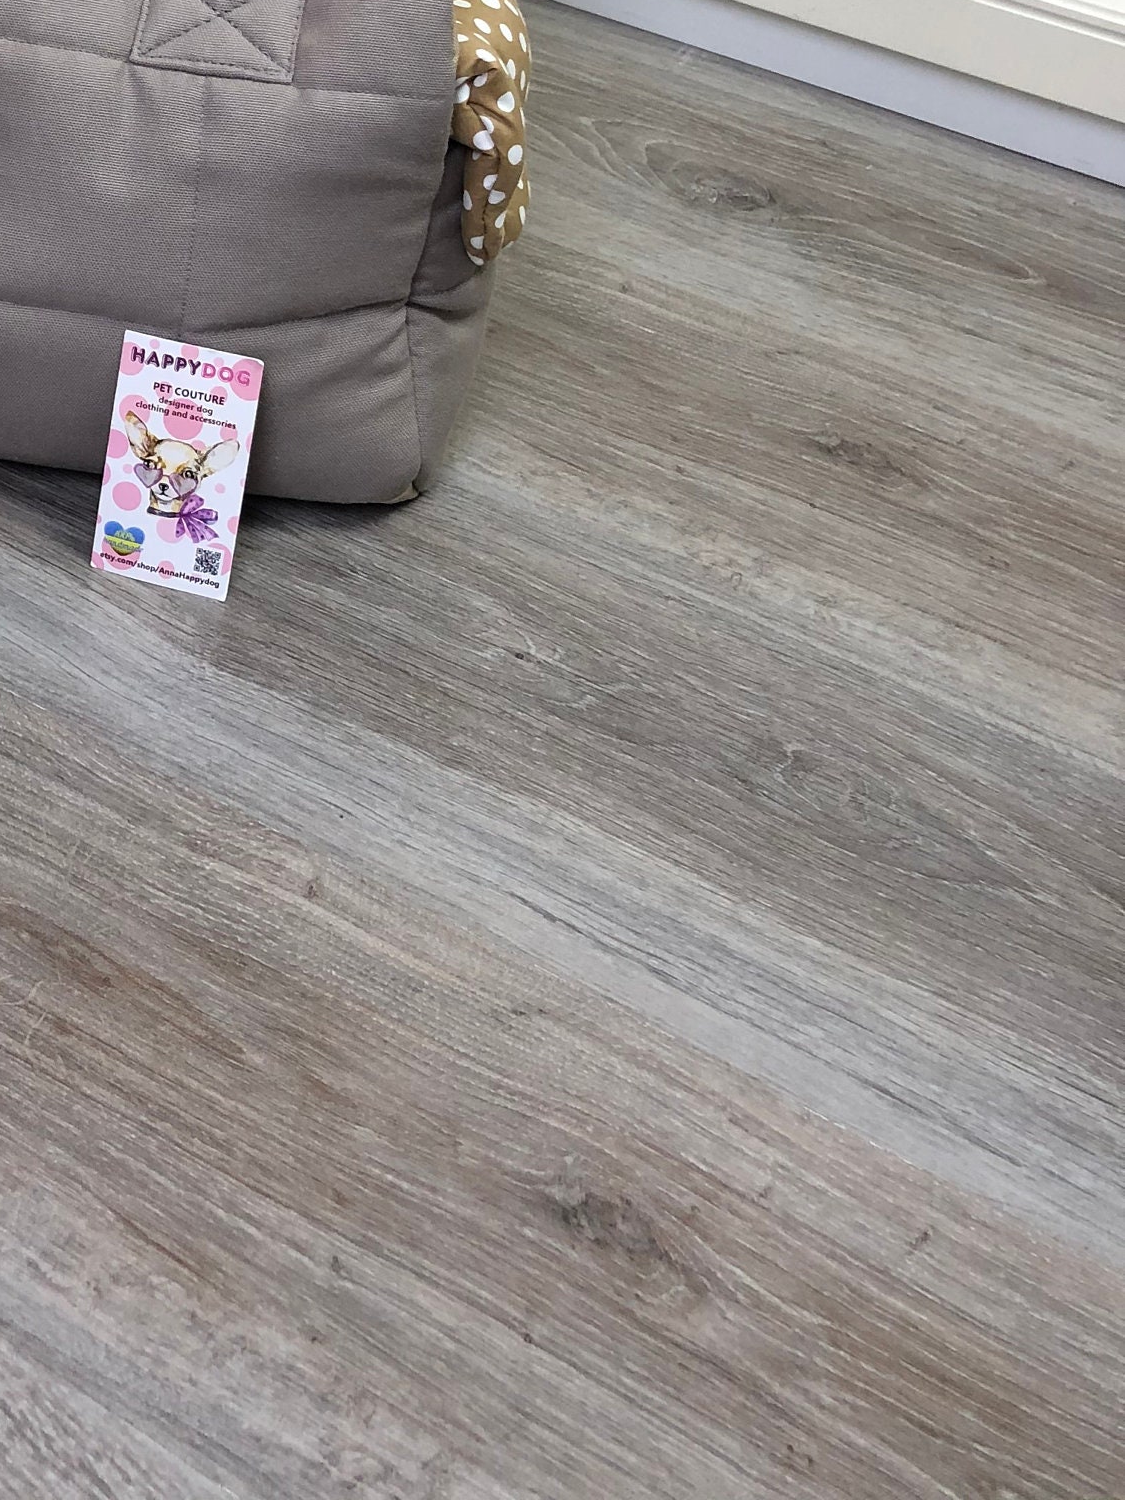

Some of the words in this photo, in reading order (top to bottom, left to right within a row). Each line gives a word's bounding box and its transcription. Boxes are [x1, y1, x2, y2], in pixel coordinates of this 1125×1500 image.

[131, 346, 251, 387] HAPPYDOG
[153, 381, 173, 394] PET
[174, 387, 226, 405] COUTURE
[158, 396, 195, 411] designer
[196, 405, 214, 416] dog
[135, 400, 170, 416] clothing
[171, 409, 188, 419] and
[189, 414, 237, 430] accessories
